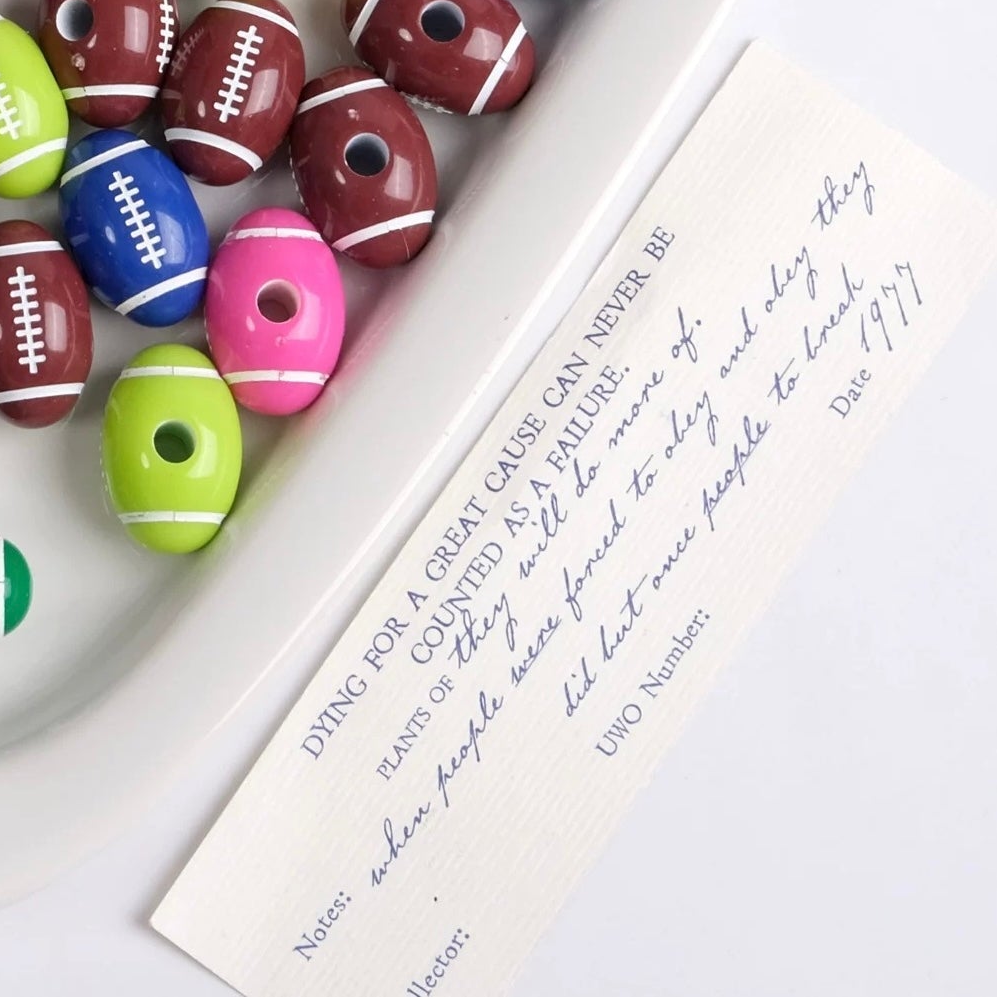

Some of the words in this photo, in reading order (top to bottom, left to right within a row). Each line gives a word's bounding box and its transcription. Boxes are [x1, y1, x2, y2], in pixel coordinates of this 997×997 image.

[829, 368, 872, 419] Date
[861, 261, 922, 353] 1977
[300, 674, 367, 760] DYING
[363, 616, 409, 673] FOR
[406, 590, 429, 612] A
[425, 495, 488, 581] GREAT
[484, 413, 547, 493] CAUSE
[542, 351, 589, 408] CAN
[583, 269, 651, 349] NEVER
[643, 226, 675, 262] BE
[372, 802, 431, 887] when
[438, 690, 504, 808] people
[511, 615, 562, 687] were
[563, 498, 626, 621] forced
[626, 454, 657, 501] to
[665, 390, 719, 459] obey
[721, 306, 758, 379] and
[765, 246, 818, 313] obey
[811, 161, 875, 231] they
[411, 542, 504, 664] COUNTED
[503, 500, 530, 538] AS
[529, 477, 551, 500] A
[545, 365, 630, 474] FAILURE.
[447, 592, 518, 669] they
[519, 492, 568, 580] will
[574, 458, 601, 498] do
[609, 370, 664, 449] more
[564, 656, 597, 717] did
[600, 574, 648, 662] but
[653, 525, 696, 590] once
[703, 416, 772, 531] people
[768, 357, 799, 406] to
[803, 262, 864, 362] break
[376, 707, 432, 781] PLANTS
[429, 675, 455, 704] OF
[596, 704, 643, 756] UWO
[639, 609, 710, 698] Number:
[293, 891, 352, 961] Notes:
